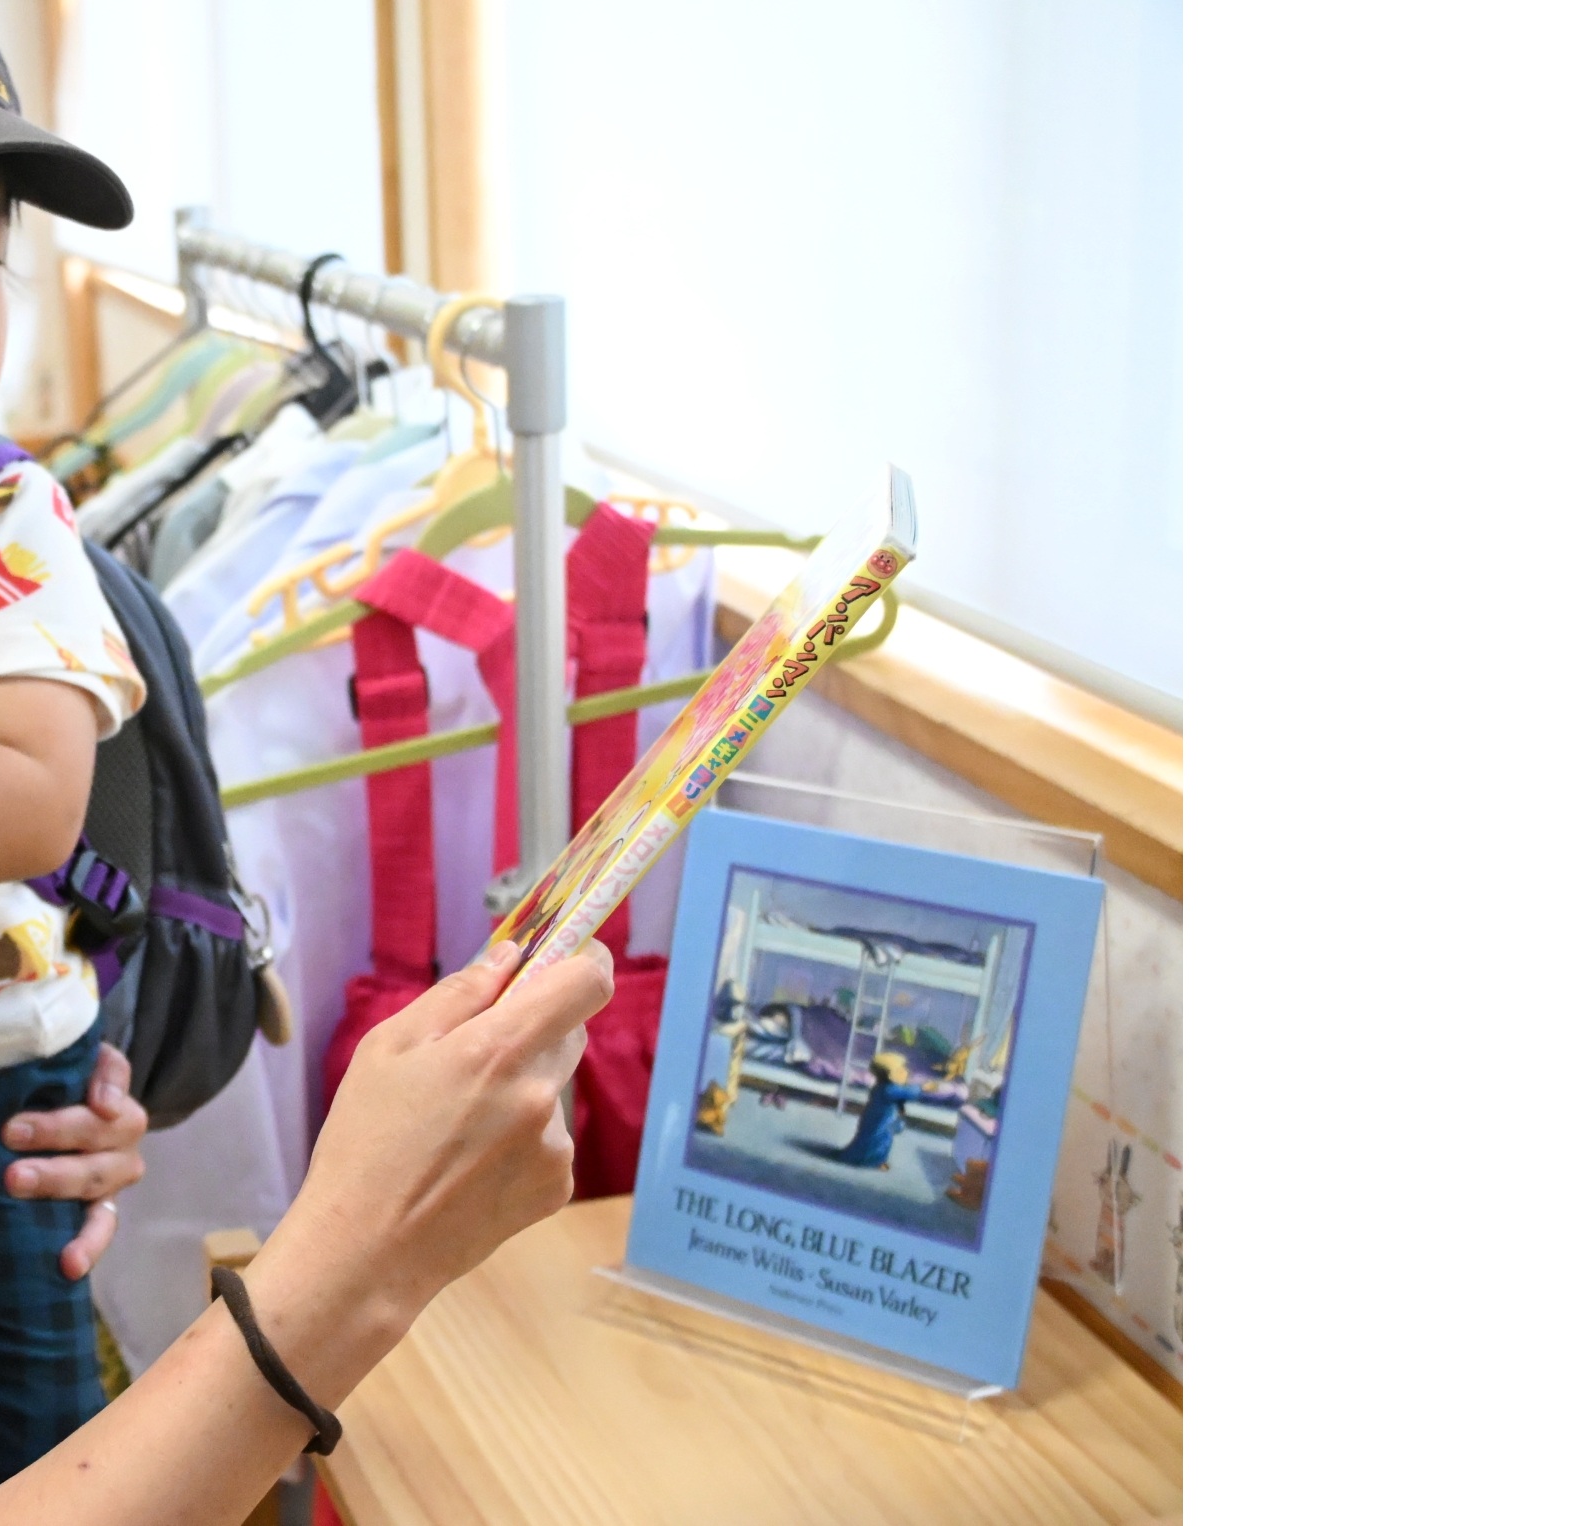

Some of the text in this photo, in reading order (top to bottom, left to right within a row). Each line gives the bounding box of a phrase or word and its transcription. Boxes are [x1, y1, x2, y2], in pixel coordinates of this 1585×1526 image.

[766, 575, 881, 699] アンパンマン
[675, 1187, 720, 1222] THE
[725, 1202, 796, 1249] LONG,
[800, 1228, 862, 1266] BLUE
[870, 1246, 972, 1300] BLAZER
[687, 1228, 749, 1265] Jeanne
[752, 1246, 805, 1283] Willis
[815, 1268, 874, 1303] Susan
[879, 1287, 939, 1328] Varley
